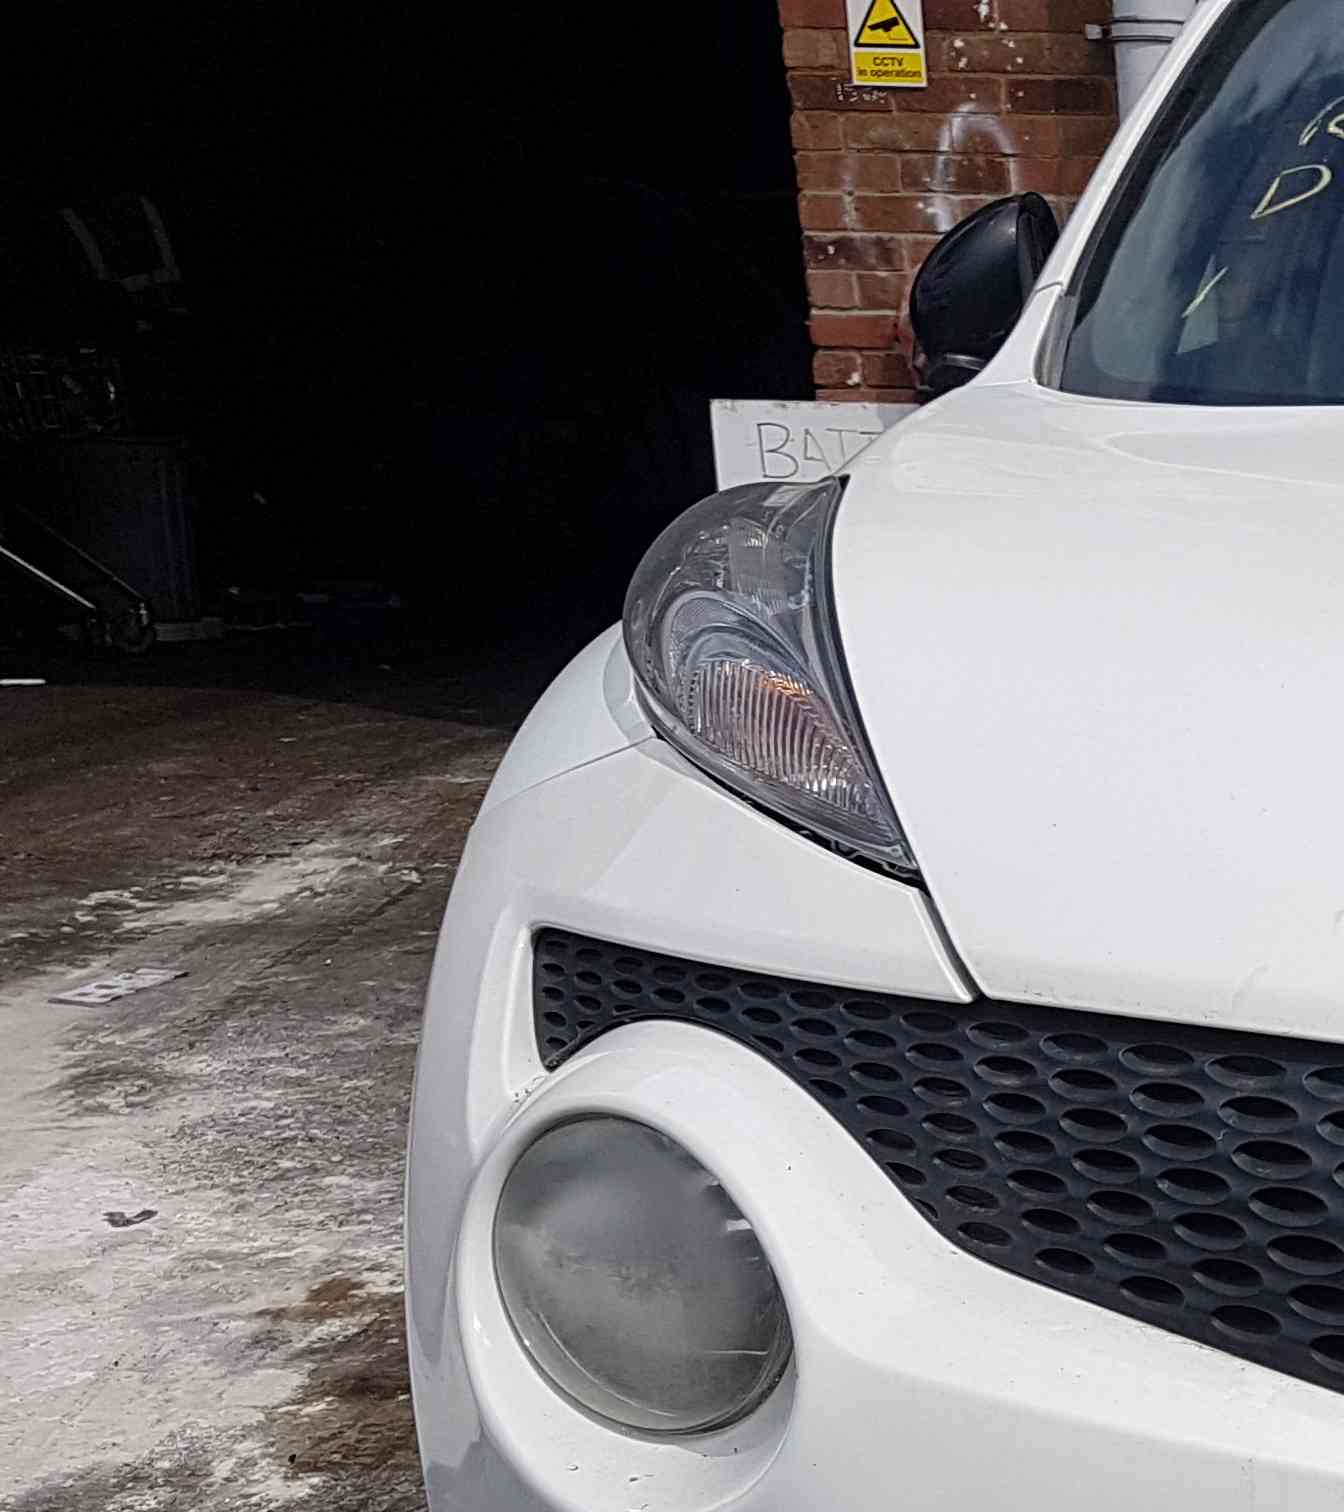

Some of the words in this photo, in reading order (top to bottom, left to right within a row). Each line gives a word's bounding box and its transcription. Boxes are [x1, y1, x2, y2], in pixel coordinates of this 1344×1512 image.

[873, 56, 904, 67] CCTV
[857, 67, 868, 77] in
[870, 68, 922, 78] operation
[757, 422, 884, 478] BAT
